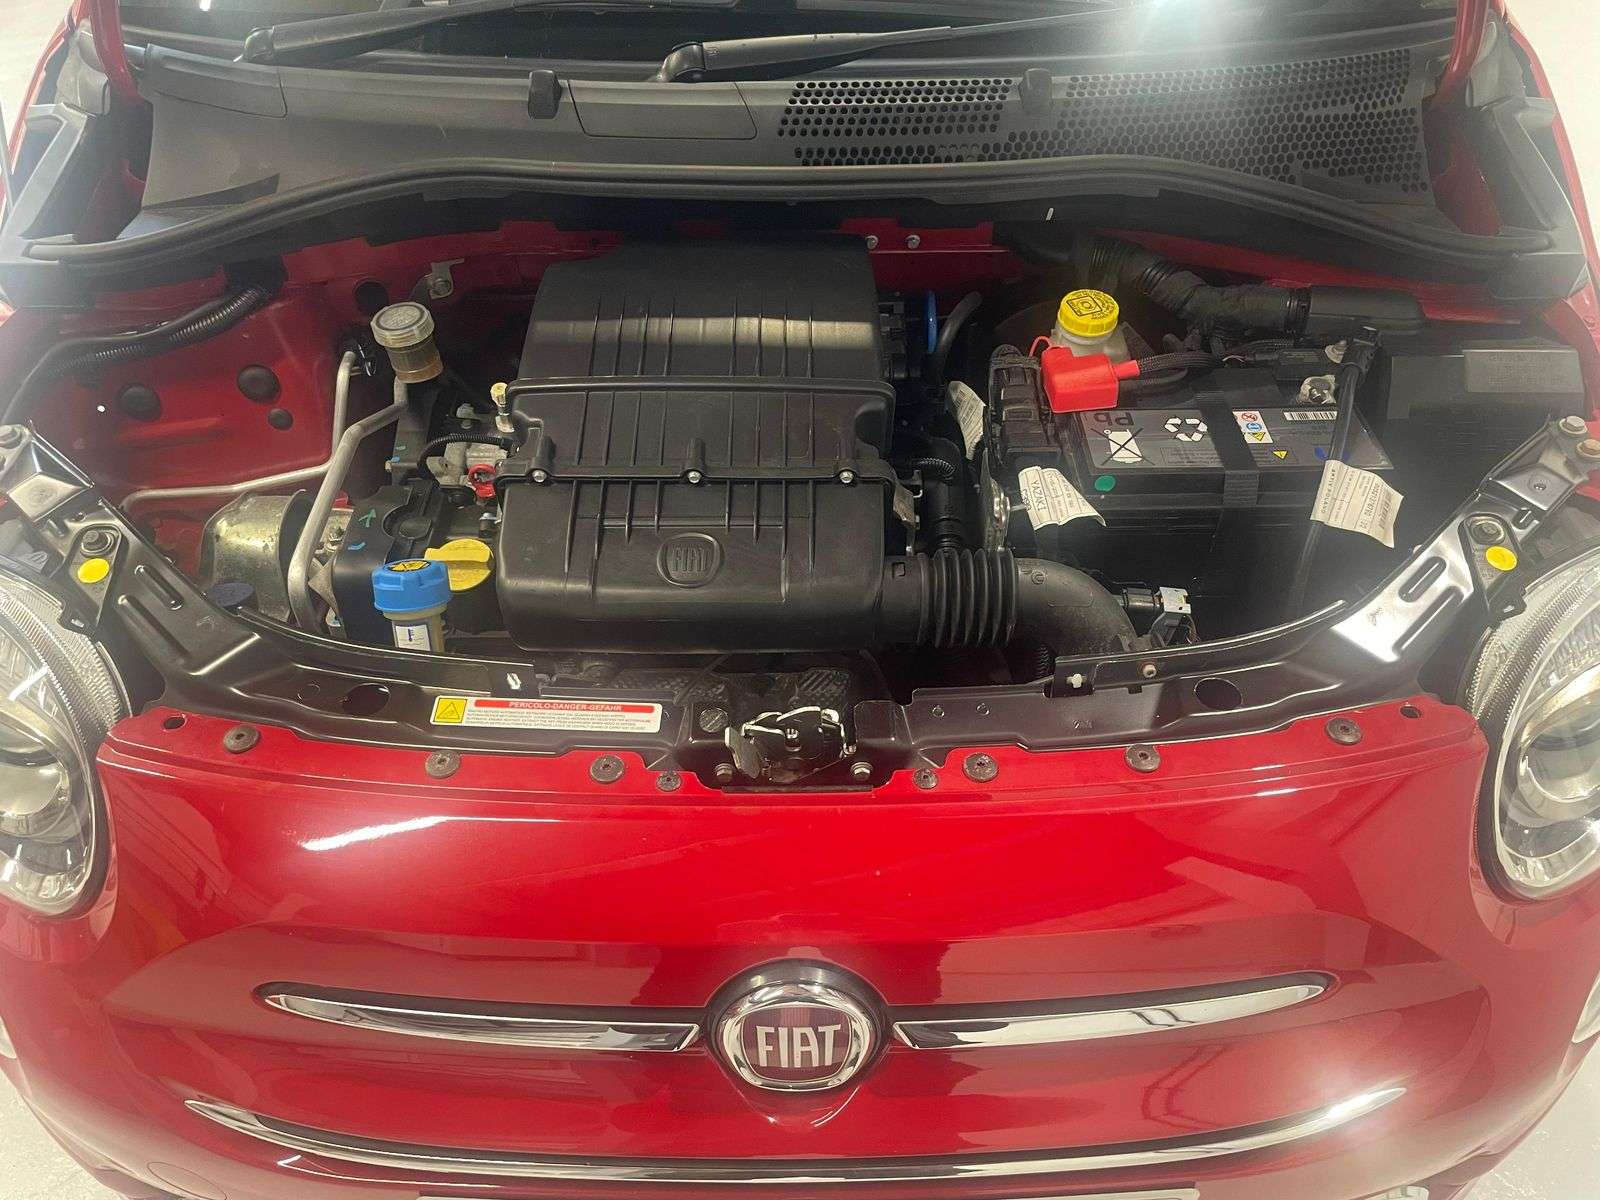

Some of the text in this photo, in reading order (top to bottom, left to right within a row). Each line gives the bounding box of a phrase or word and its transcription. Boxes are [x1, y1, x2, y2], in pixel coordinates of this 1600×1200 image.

[1093, 411, 1134, 426] Pb
[1031, 479, 1046, 511] YAZAKI
[672, 546, 706, 573] FIAT
[756, 1024, 841, 1068] FIAT
